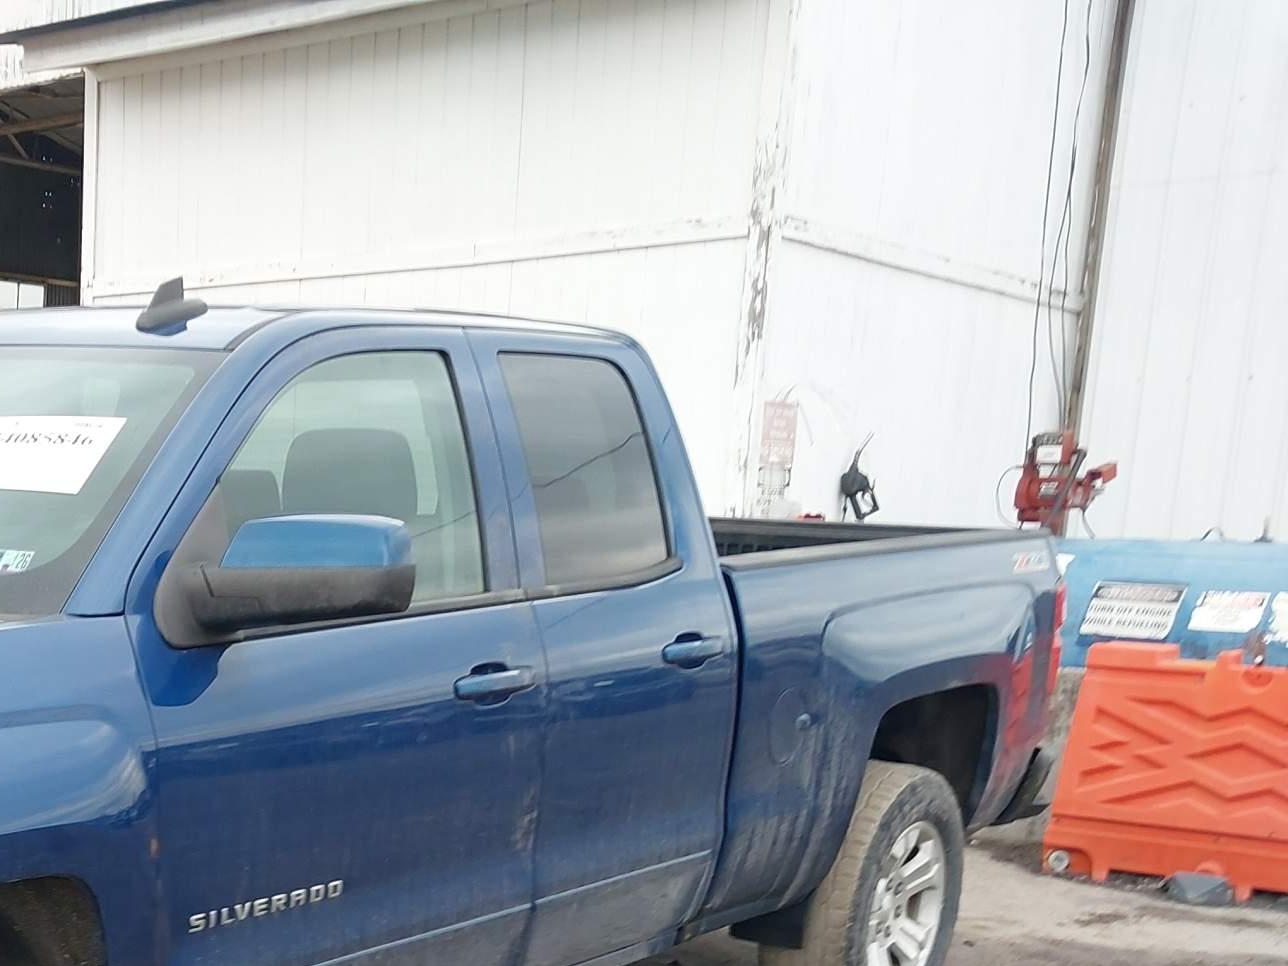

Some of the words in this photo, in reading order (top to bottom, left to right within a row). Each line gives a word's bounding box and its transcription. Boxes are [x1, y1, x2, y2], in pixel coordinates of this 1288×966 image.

[1089, 604, 1114, 612] TURN
[1115, 606, 1133, 614] OFF
[1134, 607, 1171, 617] ENGINE
[187, 879, 344, 934] SILVERADO
